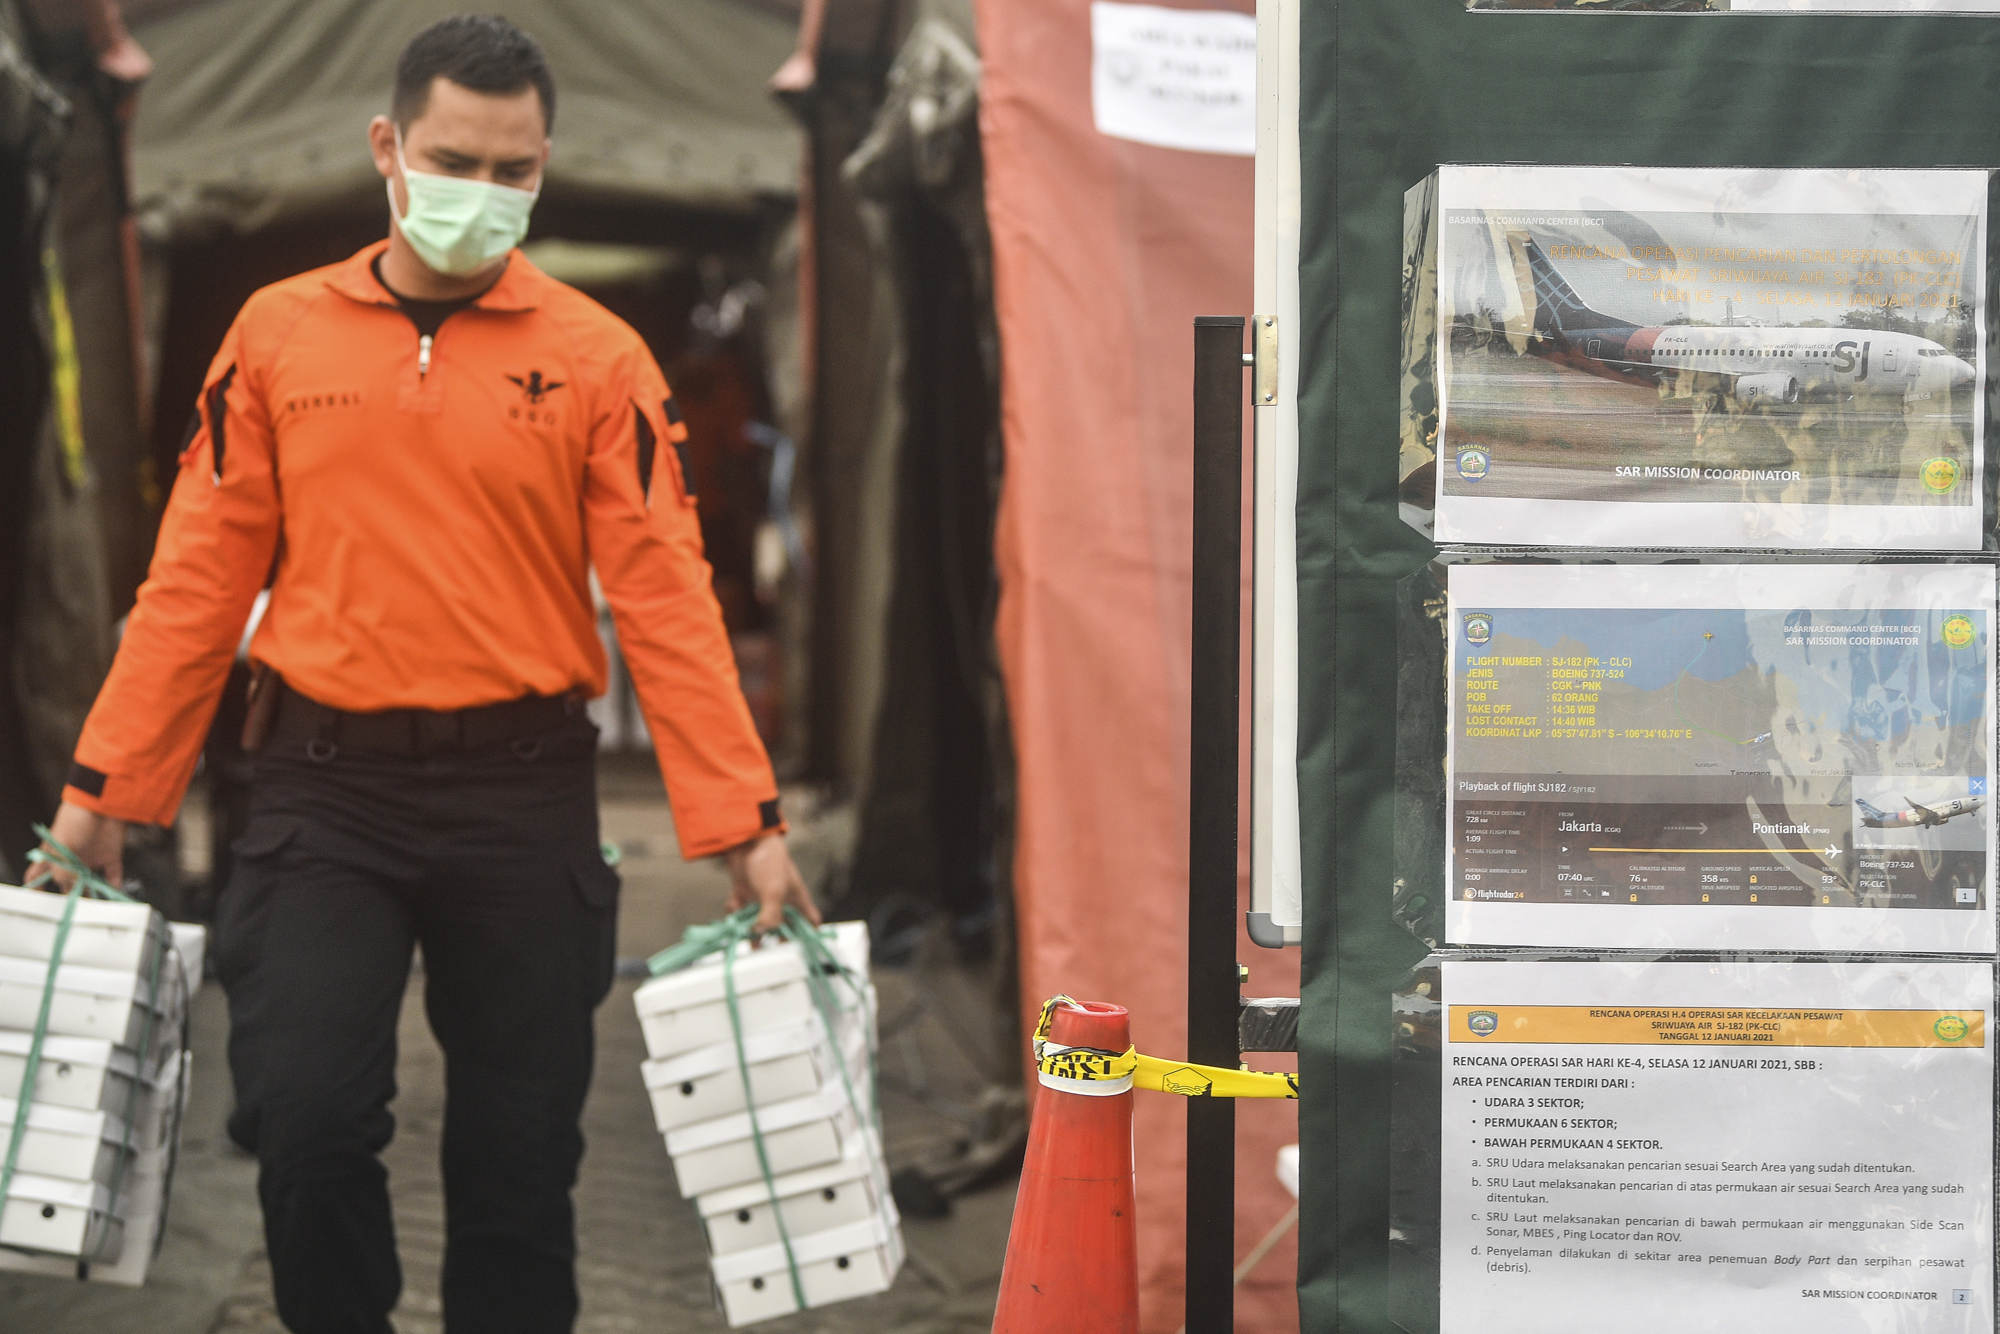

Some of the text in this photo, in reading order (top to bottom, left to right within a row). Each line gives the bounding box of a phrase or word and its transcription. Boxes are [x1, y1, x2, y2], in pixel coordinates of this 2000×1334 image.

[1497, 217, 1545, 225] COMMAND
[1547, 217, 1579, 225] CENTER
[1550, 245, 1961, 265] RENCANA OPERASI PENCARIAN DAN PERTOLONGAN
[1627, 266, 1700, 282] PESAWAT
[1834, 340, 1870, 381] SJ
[1615, 466, 1800, 481] SAR MISSION COORDINATOR
[1783, 625, 1825, 633] BASARNAS
[1826, 625, 1868, 633] COMMAND
[1900, 626, 1921, 634] (BCC)
[1786, 637, 1918, 646] SAR MISSION COORDINATOR
[1467, 657, 1632, 668] FLIGHT NUMBER SJ-182 (PK CLC)
[1467, 669, 1624, 678] JENIS BOEING 737-524
[1467, 681, 1602, 690] ROUTE CGK PNK
[1467, 693, 1598, 702] POB 62 ORANG
[1467, 705, 1596, 714] TAKE OFF WIB
[1467, 717, 1596, 726] LOST CONTACT 14:40 WIB
[1466, 728, 1542, 737] KOORDINAT LKP
[1460, 782, 1566, 793] Playback of flight SJ182
[1558, 821, 1601, 832] Jakarta
[1753, 823, 1810, 834] Pontianak
[1860, 861, 1885, 869] Boeing
[1701, 875, 1718, 883] 358
[1590, 1010, 1631, 1018] RENCANA
[1634, 1010, 1669, 1018] OPERASI
[1689, 1011, 1723, 1019] OPERASI
[1727, 1011, 1743, 1019] SAR
[1804, 1012, 1843, 1020] PESAWAT
[1746, 1023, 1781, 1032] (PK-CLC)
[1714, 1033, 1751, 1041] JANUARI
[1453, 1056, 1815, 1071] RENCANA OPERASI SAR HARI KE-4, SELASA 12 JANUARI 2021, SBB
[1453, 1077, 1628, 1088] AREA PENCARIAN TERDIRI DARI
[1484, 1098, 1584, 1109] UDARA 3 SEKTOR;
[1484, 1118, 1617, 1130] PERMUKAAN 6 SEKTOR;
[1484, 1138, 1663, 1150] BAWAH PERMUKAAN 4 SEKTOR.
[1487, 1158, 1915, 1174] SRU Udara melaksanakan pencarian sesuai Search Area yang sudah ditentukan.
[1487, 1178, 1964, 1196] SRU Laut melaksanakan pencarian di atas permukaan air sesuai Search Area yang sudah
[1487, 1193, 1549, 1203] ditentukan.
[1487, 1213, 1964, 1231] SRU Laut melaksanakan pencarian di bawah permukaan air menggunakan Side Scan
[1487, 1228, 1682, 1242] Sonar, MBES Ping Locator dan ROV.
[1487, 1247, 1964, 1268] Penyelaman dilakukan di sekitar area penemuan Body Part dan serpihan pesawat
[1487, 1262, 1531, 1273] (debris).
[1801, 1290, 1938, 1300] SAR MISSION COORDINATOR
